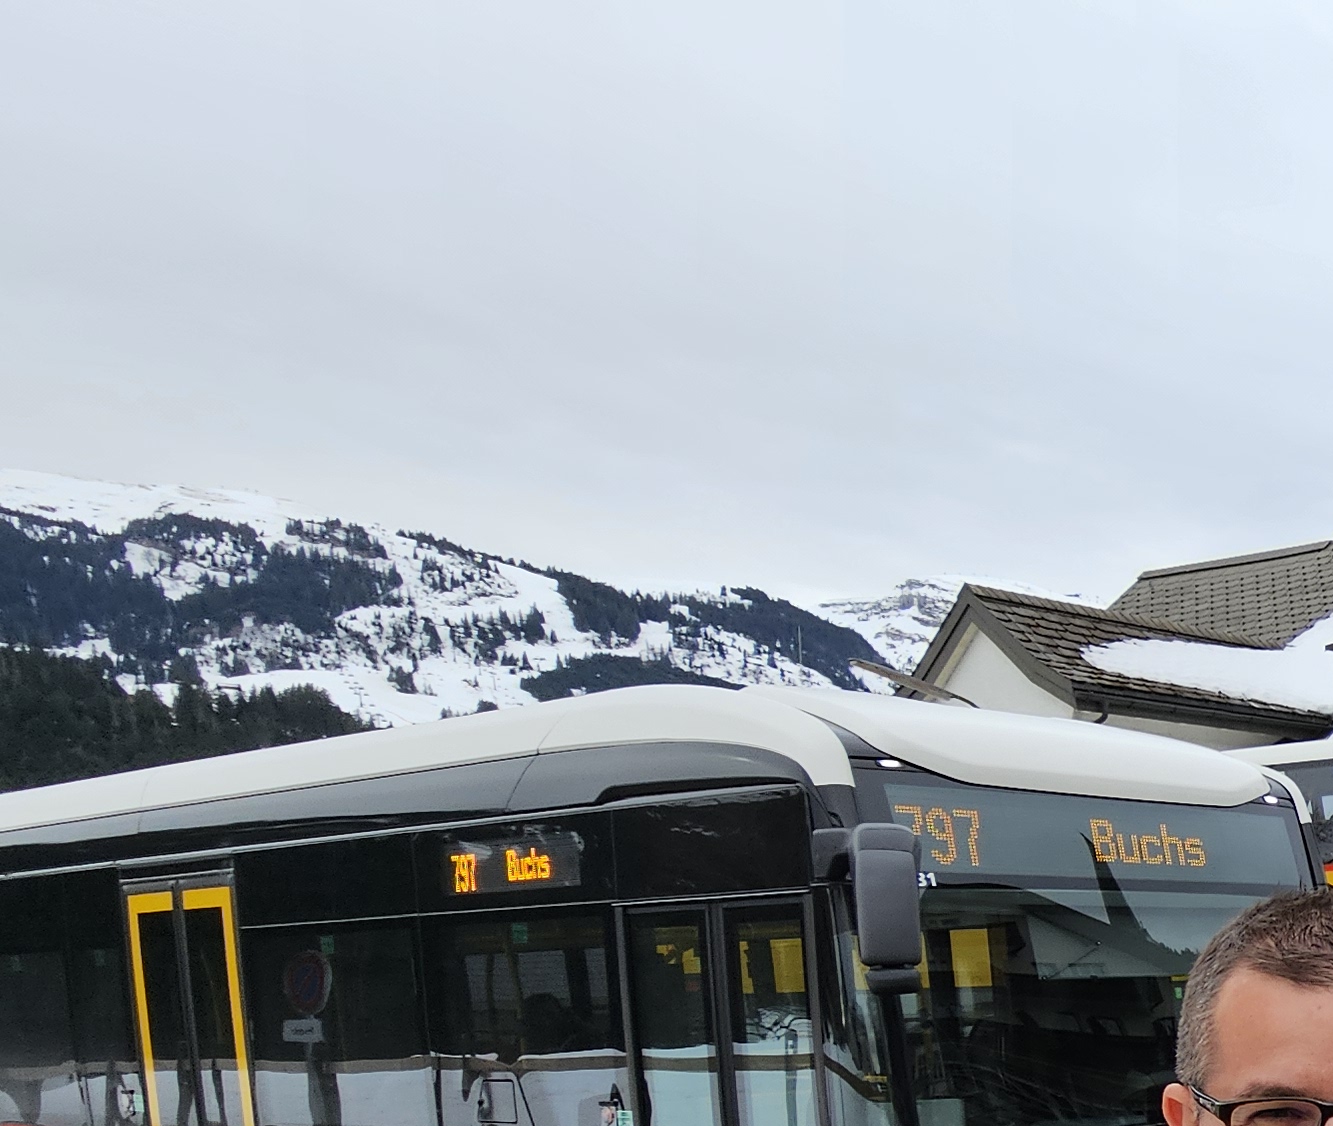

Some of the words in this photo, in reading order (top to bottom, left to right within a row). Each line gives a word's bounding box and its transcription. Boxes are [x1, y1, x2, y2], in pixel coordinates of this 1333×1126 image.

[894, 804, 980, 867] 797
[1090, 818, 1206, 867] Buchs
[451, 854, 477, 892] 797
[506, 847, 551, 881] Buchs
[917, 872, 938, 887] 31
